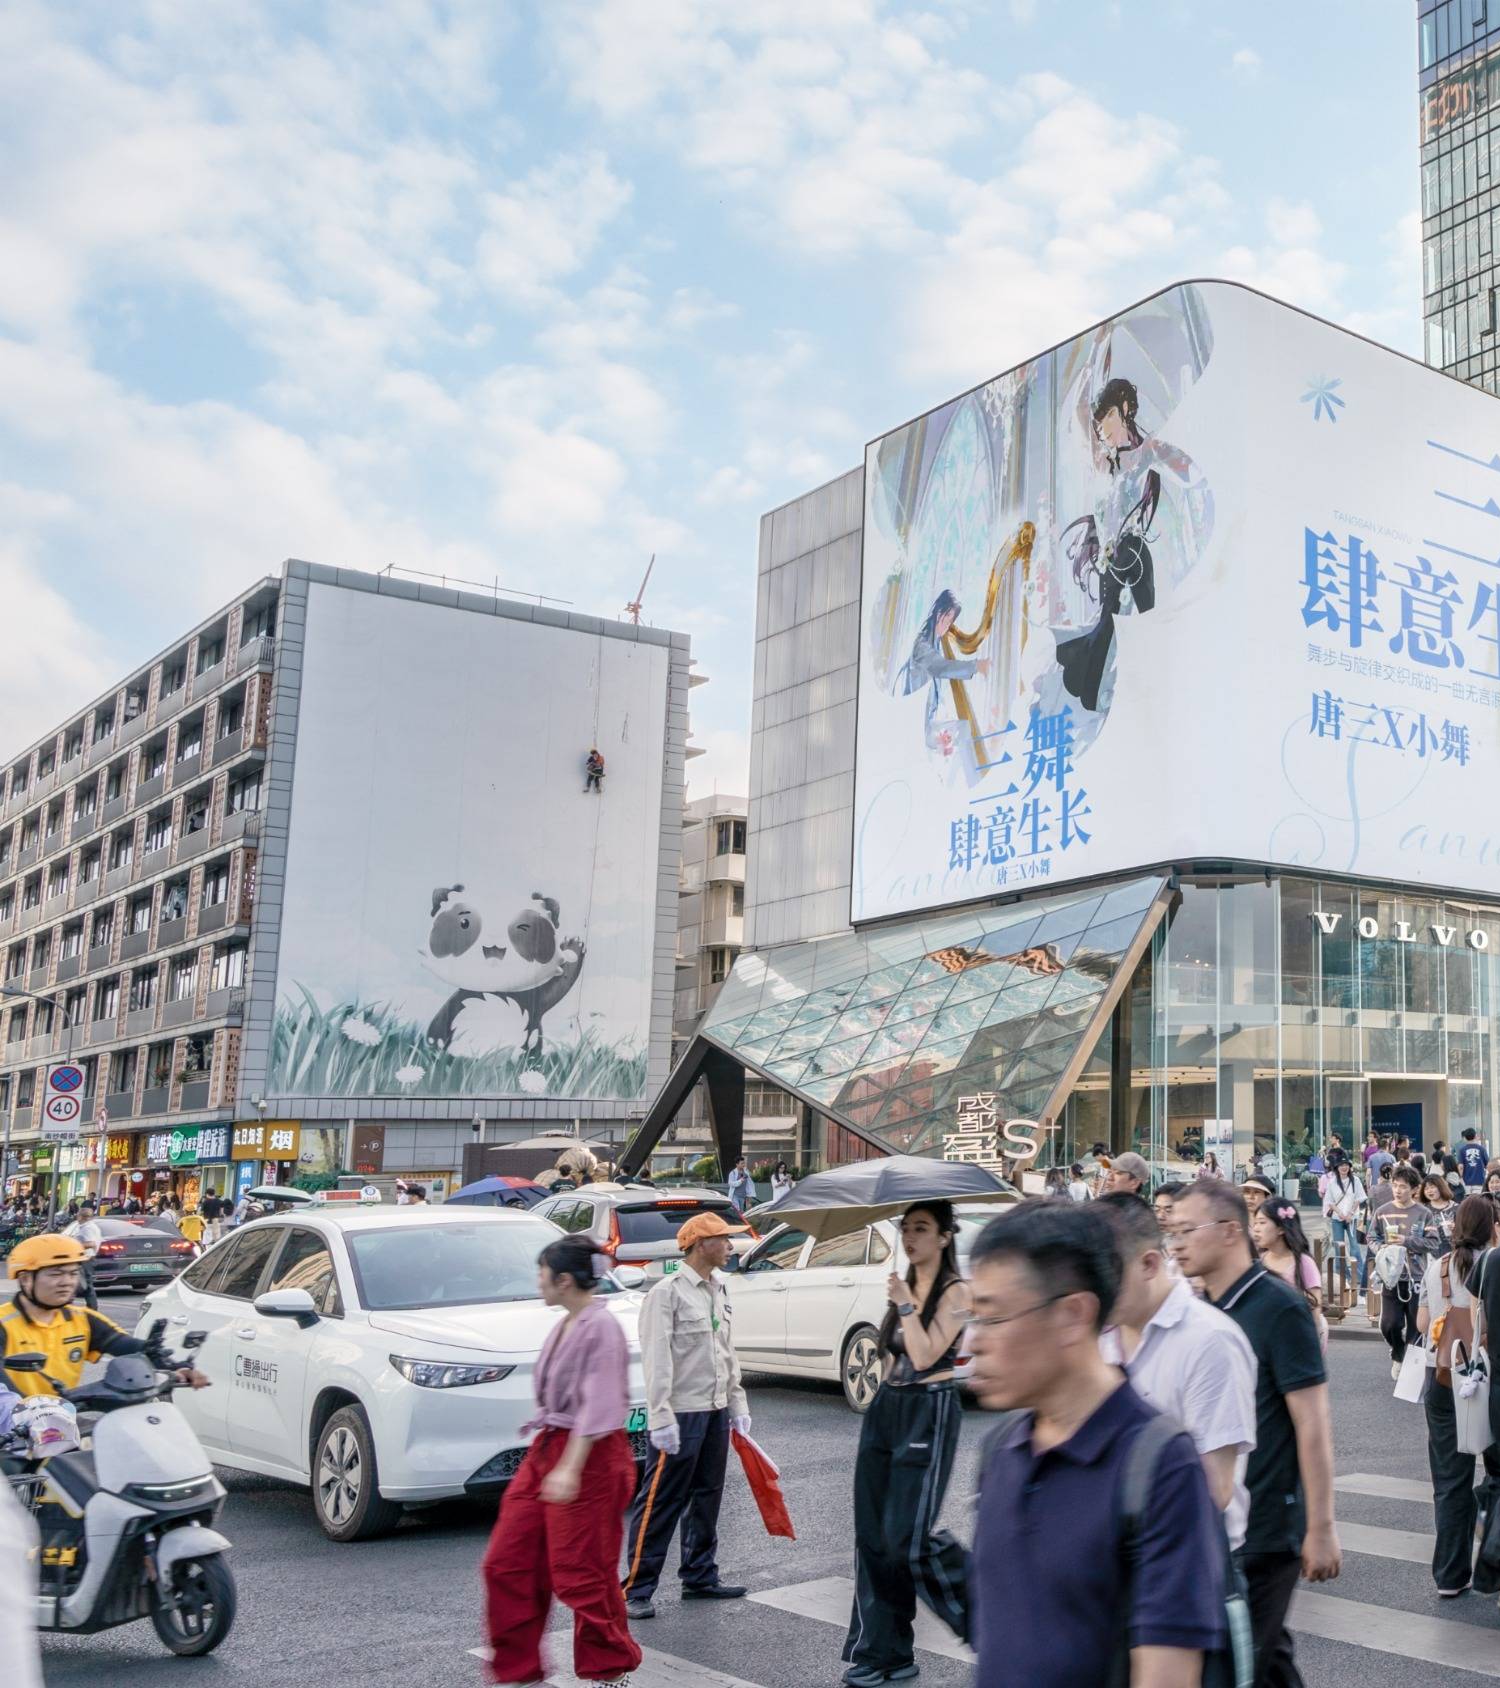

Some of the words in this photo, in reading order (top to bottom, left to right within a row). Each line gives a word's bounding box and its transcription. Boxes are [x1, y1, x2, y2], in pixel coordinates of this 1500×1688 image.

[969, 704, 1076, 804] 三舞
[948, 788, 1093, 873] 肆意生长
[1312, 911, 1489, 949] VOLVO
[53, 1101, 73, 1115] 40
[270, 1129, 295, 1151] 烟
